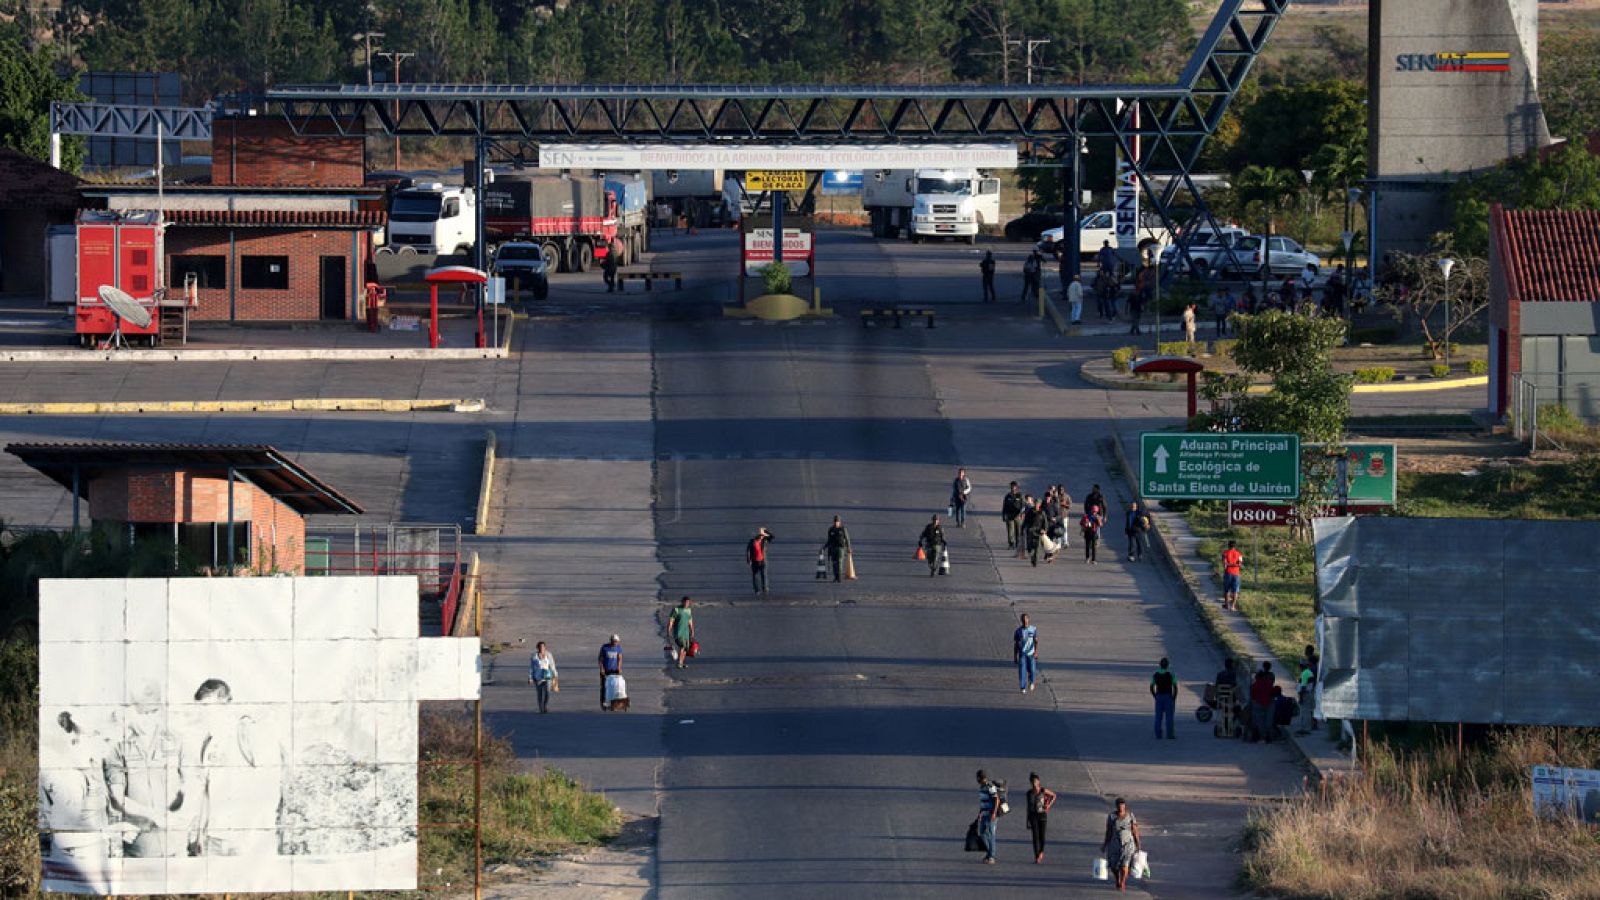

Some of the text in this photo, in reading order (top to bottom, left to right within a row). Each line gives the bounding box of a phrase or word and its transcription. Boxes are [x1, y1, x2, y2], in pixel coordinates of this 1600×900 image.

[640, 152, 705, 164] BIENVENIDOS
[708, 152, 716, 163] A
[718, 152, 731, 163] LA
[733, 152, 773, 163] ADUANA
[776, 152, 824, 163] PRINCIPAL
[1117, 159, 1135, 236] SENIAT
[1180, 440, 1289, 454] Aduana Principal
[1179, 460, 1260, 474] Ecológica de
[1149, 481, 1291, 493] Santa Elena de Uairén
